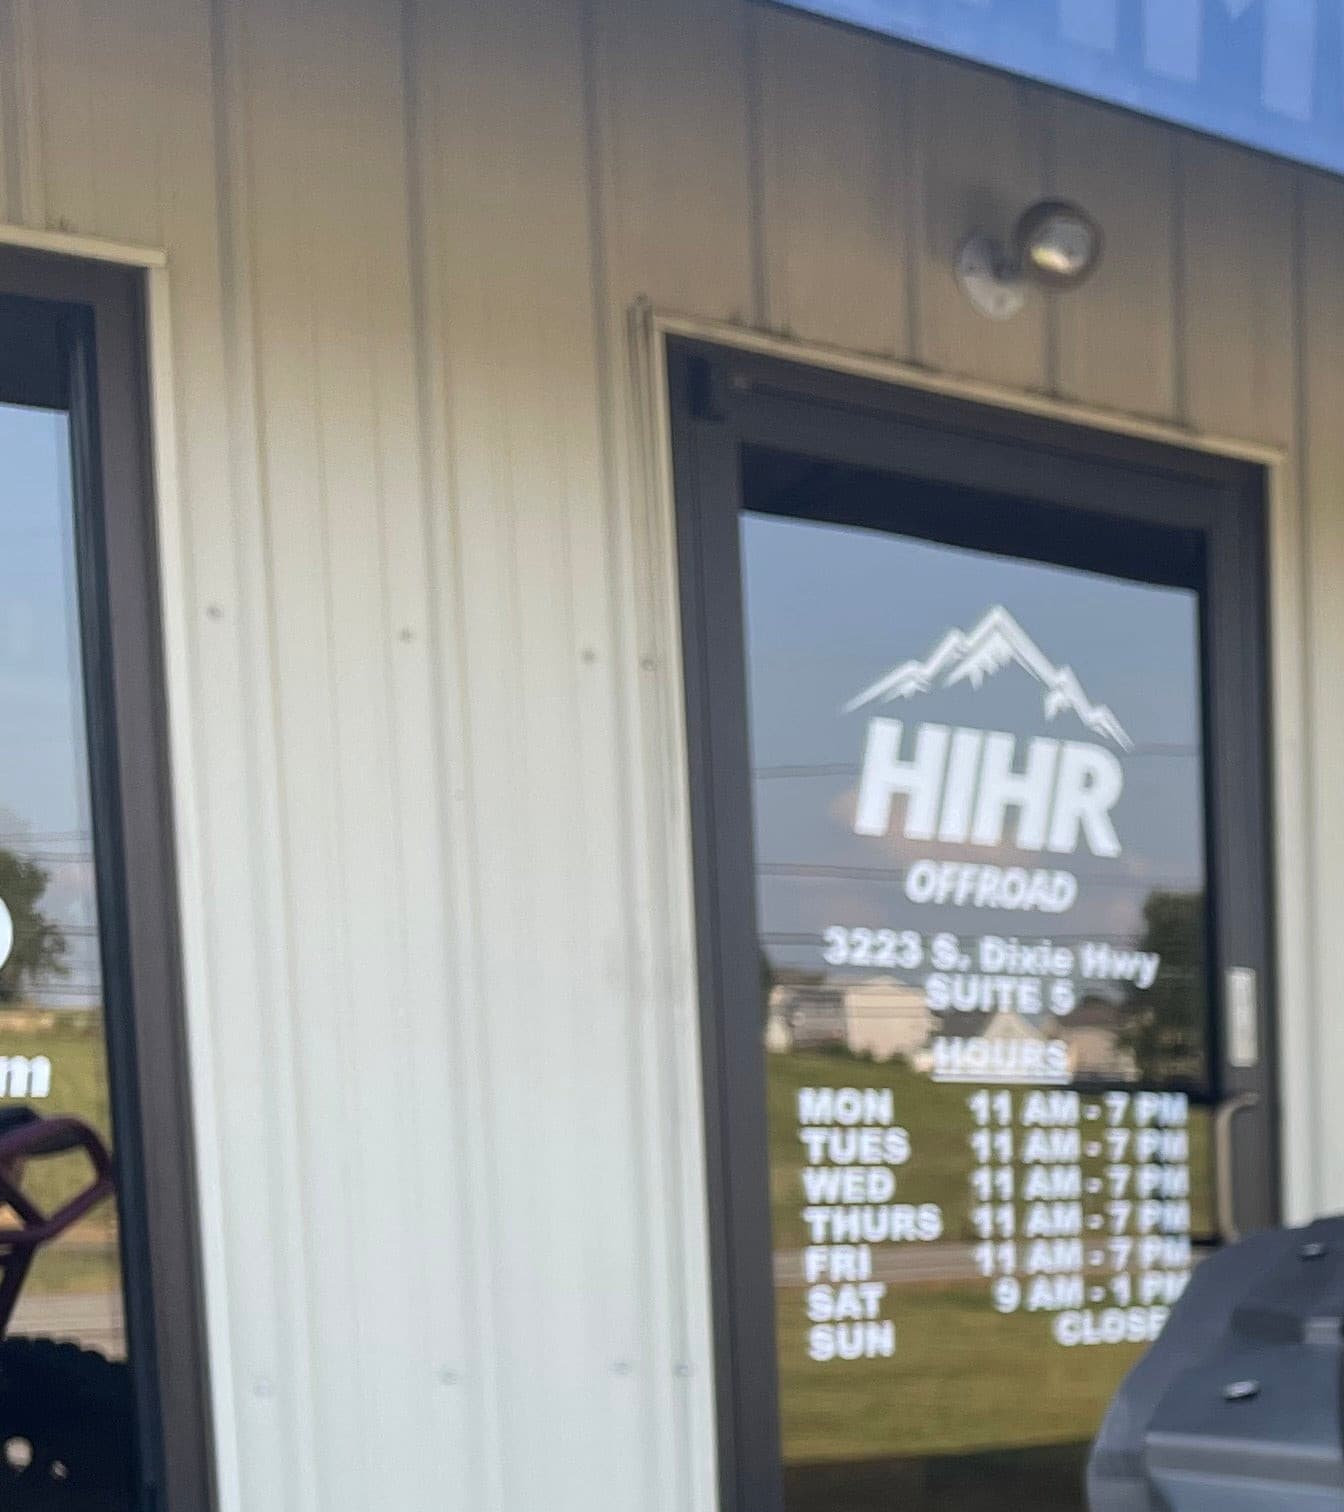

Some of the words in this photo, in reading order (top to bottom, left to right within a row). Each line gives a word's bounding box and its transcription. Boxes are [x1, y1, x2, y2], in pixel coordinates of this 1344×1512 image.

[854, 716, 1124, 858] HIHR
[905, 859, 1077, 913] OFFROAD
[823, 925, 921, 969] 3223
[932, 933, 971, 972] S.
[980, 935, 1074, 976] Dixie
[1079, 941, 1159, 989] Hwy
[926, 973, 1041, 1015] SUITE
[933, 1036, 1069, 1071] HOURS
[798, 1088, 893, 1124] MON
[970, 1090, 1012, 1125] 11
[1023, 1090, 1081, 1125] AM
[1104, 1092, 1130, 1126] 7
[1135, 1092, 1188, 1126] PM
[798, 1128, 910, 1165] TUES
[971, 1128, 1012, 1163] 11
[1023, 1128, 1081, 1163] AM
[1105, 1130, 1130, 1164] 7
[1135, 1130, 1188, 1164] PM
[802, 1167, 895, 1203] WED
[971, 1166, 1013, 1201] 11
[1023, 1166, 1082, 1201] AM
[1106, 1167, 1131, 1201] 7
[1136, 1167, 1189, 1201] PM
[803, 1203, 944, 1242] THURS
[972, 1203, 1013, 1238] 11
[1024, 1203, 1082, 1238] AM
[1107, 1203, 1131, 1236] 7
[1137, 1203, 1190, 1236] PM
[806, 1246, 872, 1282] FRI
[973, 1240, 1015, 1275] 11
[1025, 1240, 1083, 1275] AM
[1108, 1237, 1132, 1271] 7
[1138, 1237, 1191, 1271] PM
[808, 1284, 887, 1321] SAT
[1026, 1275, 1084, 1312] AM
[809, 1321, 894, 1361] SUN
[1055, 1304, 1170, 1346] CLOSE
